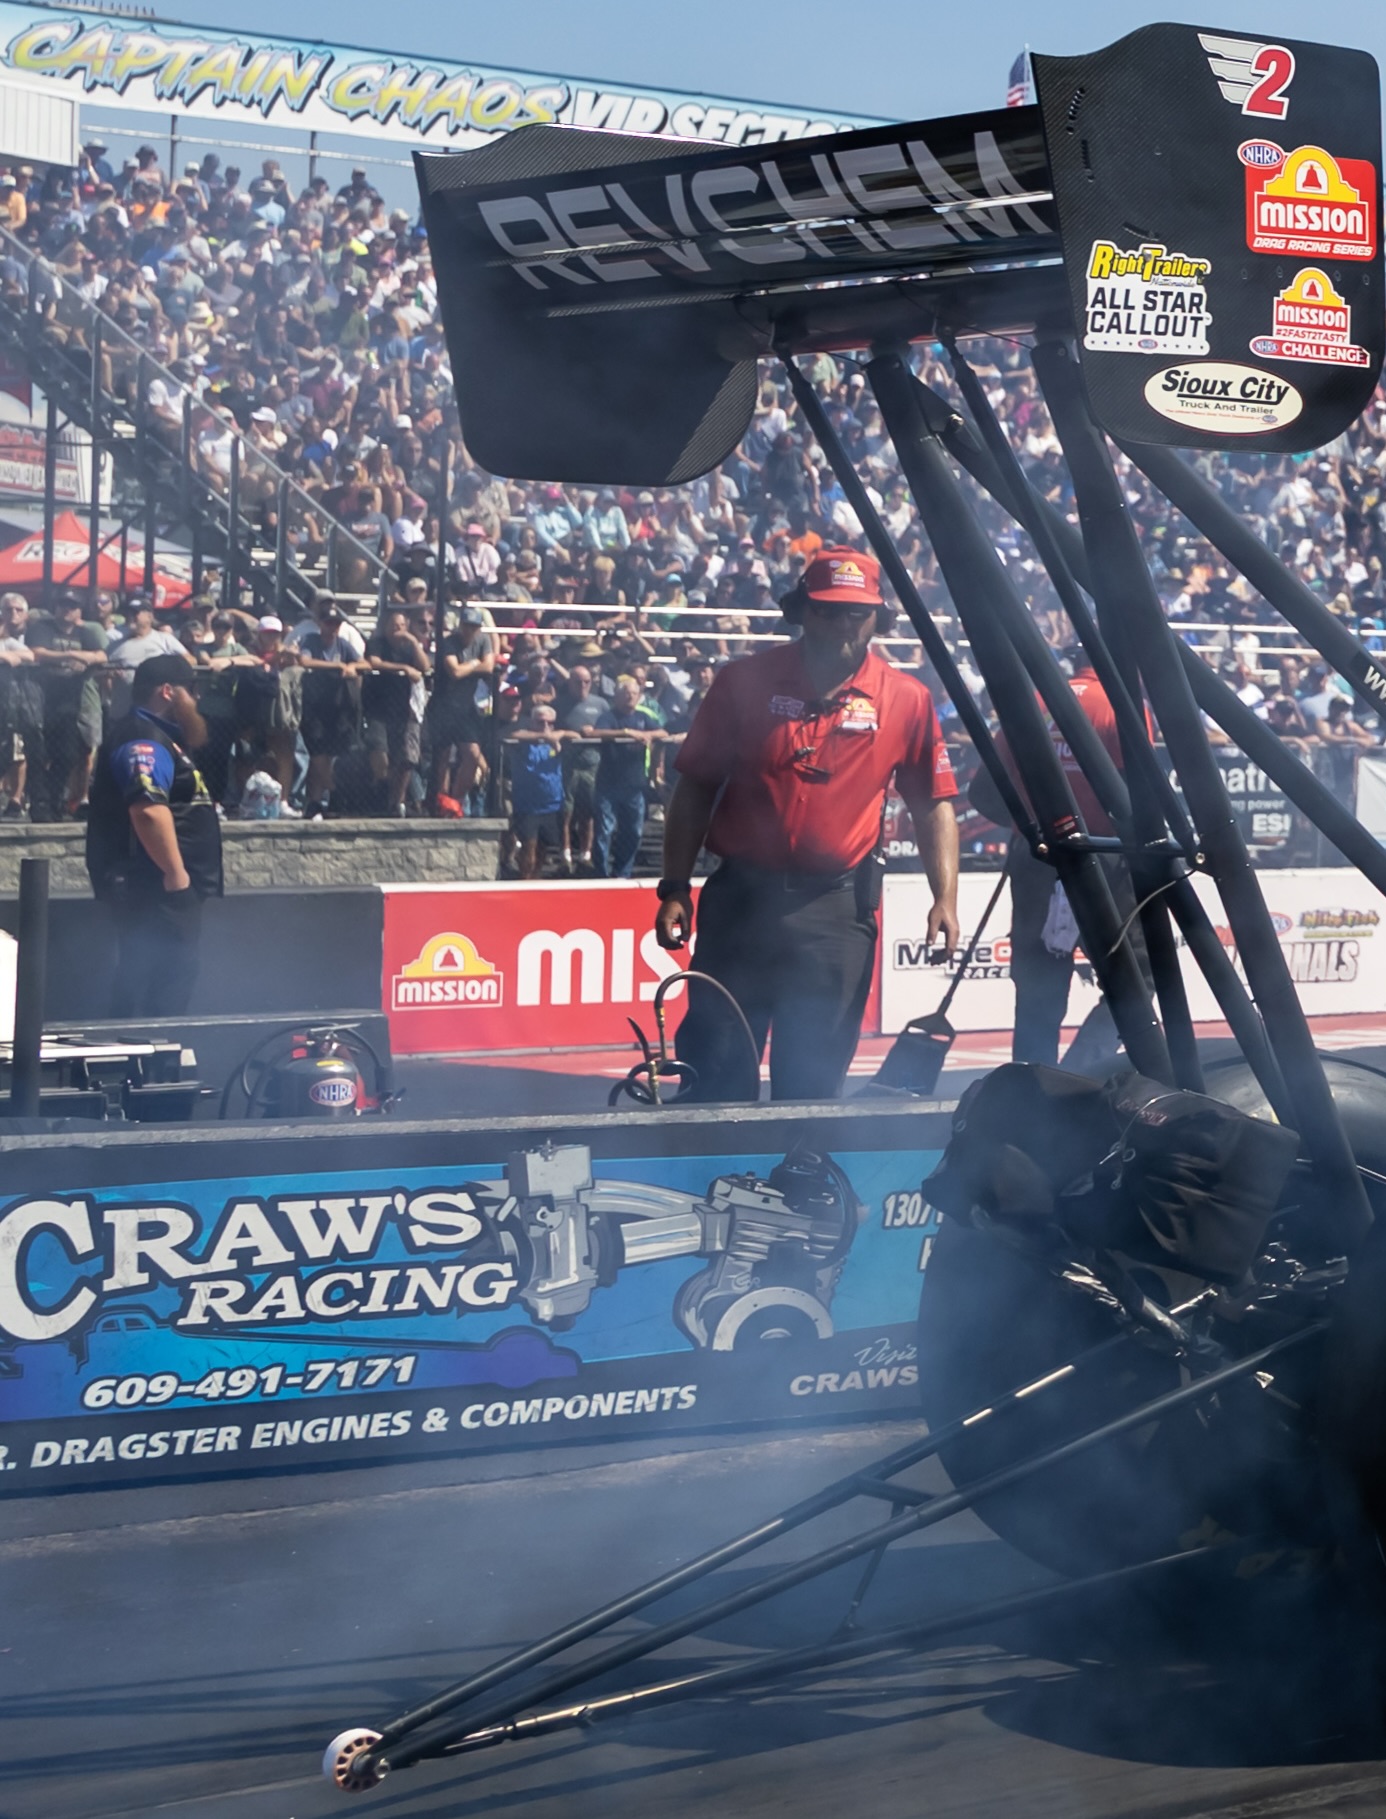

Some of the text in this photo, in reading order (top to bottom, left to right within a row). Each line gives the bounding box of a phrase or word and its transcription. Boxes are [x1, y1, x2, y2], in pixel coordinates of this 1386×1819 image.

[3, 17, 333, 112] CAPTAIN
[328, 60, 570, 134] CHAOS
[1241, 44, 1296, 120] 2
[1245, 145, 1280, 166] NHRA
[478, 130, 1054, 292] REVCHEM
[1253, 237, 1373, 257] DRAG RACING SERIES
[1090, 286, 1204, 315] ALL STAR
[1090, 311, 1204, 339] CALLOUT
[1276, 328, 1348, 343] #2FAST2TASTY
[1255, 340, 1366, 362] NHRA CHALLENGE
[1161, 370, 1290, 402] Sioux City
[1179, 400, 1210, 410] Truck
[1215, 403, 1236, 412] And
[1241, 405, 1275, 416] Trailer
[1254, 813, 1290, 832] ESI
[318, 1087, 356, 1102] NHRA
[0, 1193, 482, 1341] CRAW'S
[177, 1263, 518, 1326] RACING
[83, 1356, 416, 1408] 609-491-7171
[790, 1364, 920, 1397] CRAWS
[31, 1425, 242, 1469] DRAGSTER
[250, 1410, 412, 1447] ENGINES
[422, 1408, 450, 1432] &
[460, 1385, 698, 1427] COMPONENTS
